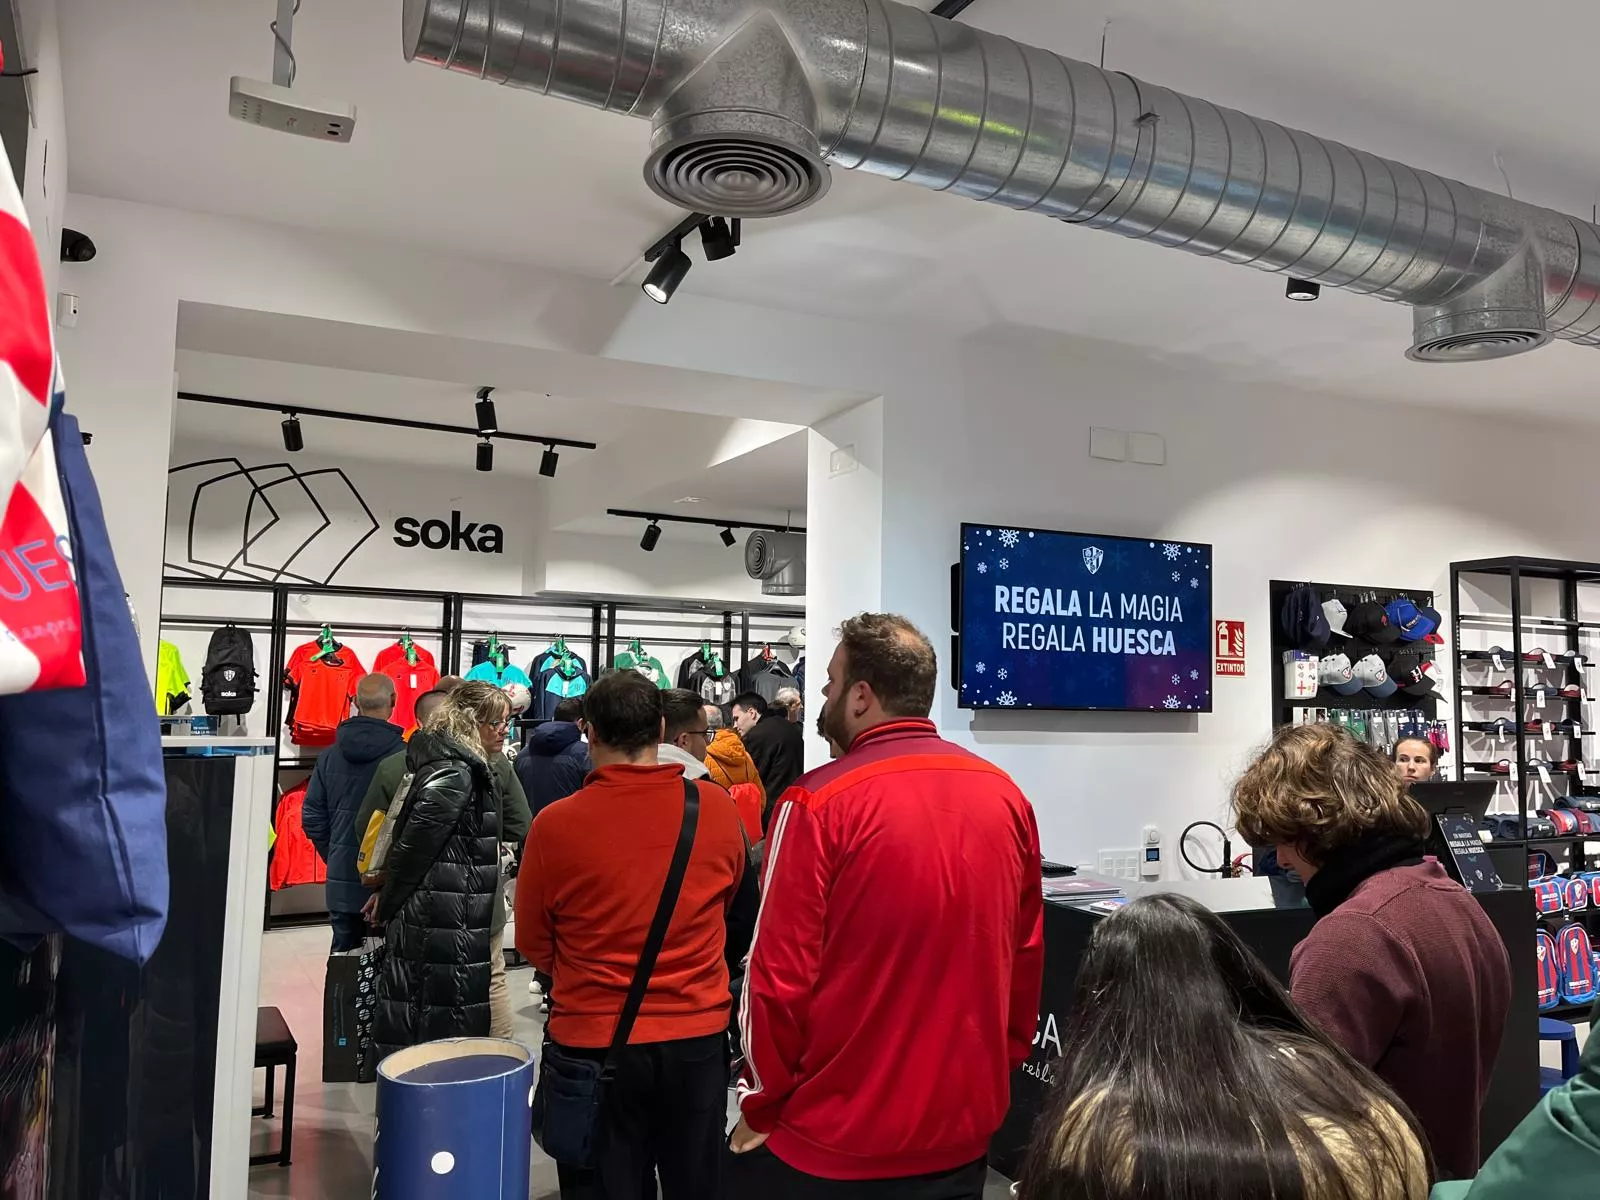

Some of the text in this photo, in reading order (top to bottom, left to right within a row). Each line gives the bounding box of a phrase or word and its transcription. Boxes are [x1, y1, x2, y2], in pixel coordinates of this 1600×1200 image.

[394, 511, 503, 553] soka
[995, 585, 1183, 623] REGALA LA MAGIA
[1002, 623, 1177, 656] REGALA HUESCA
[1216, 662, 1245, 673] EXTINTOR
[1032, 1013, 1063, 1057] A
